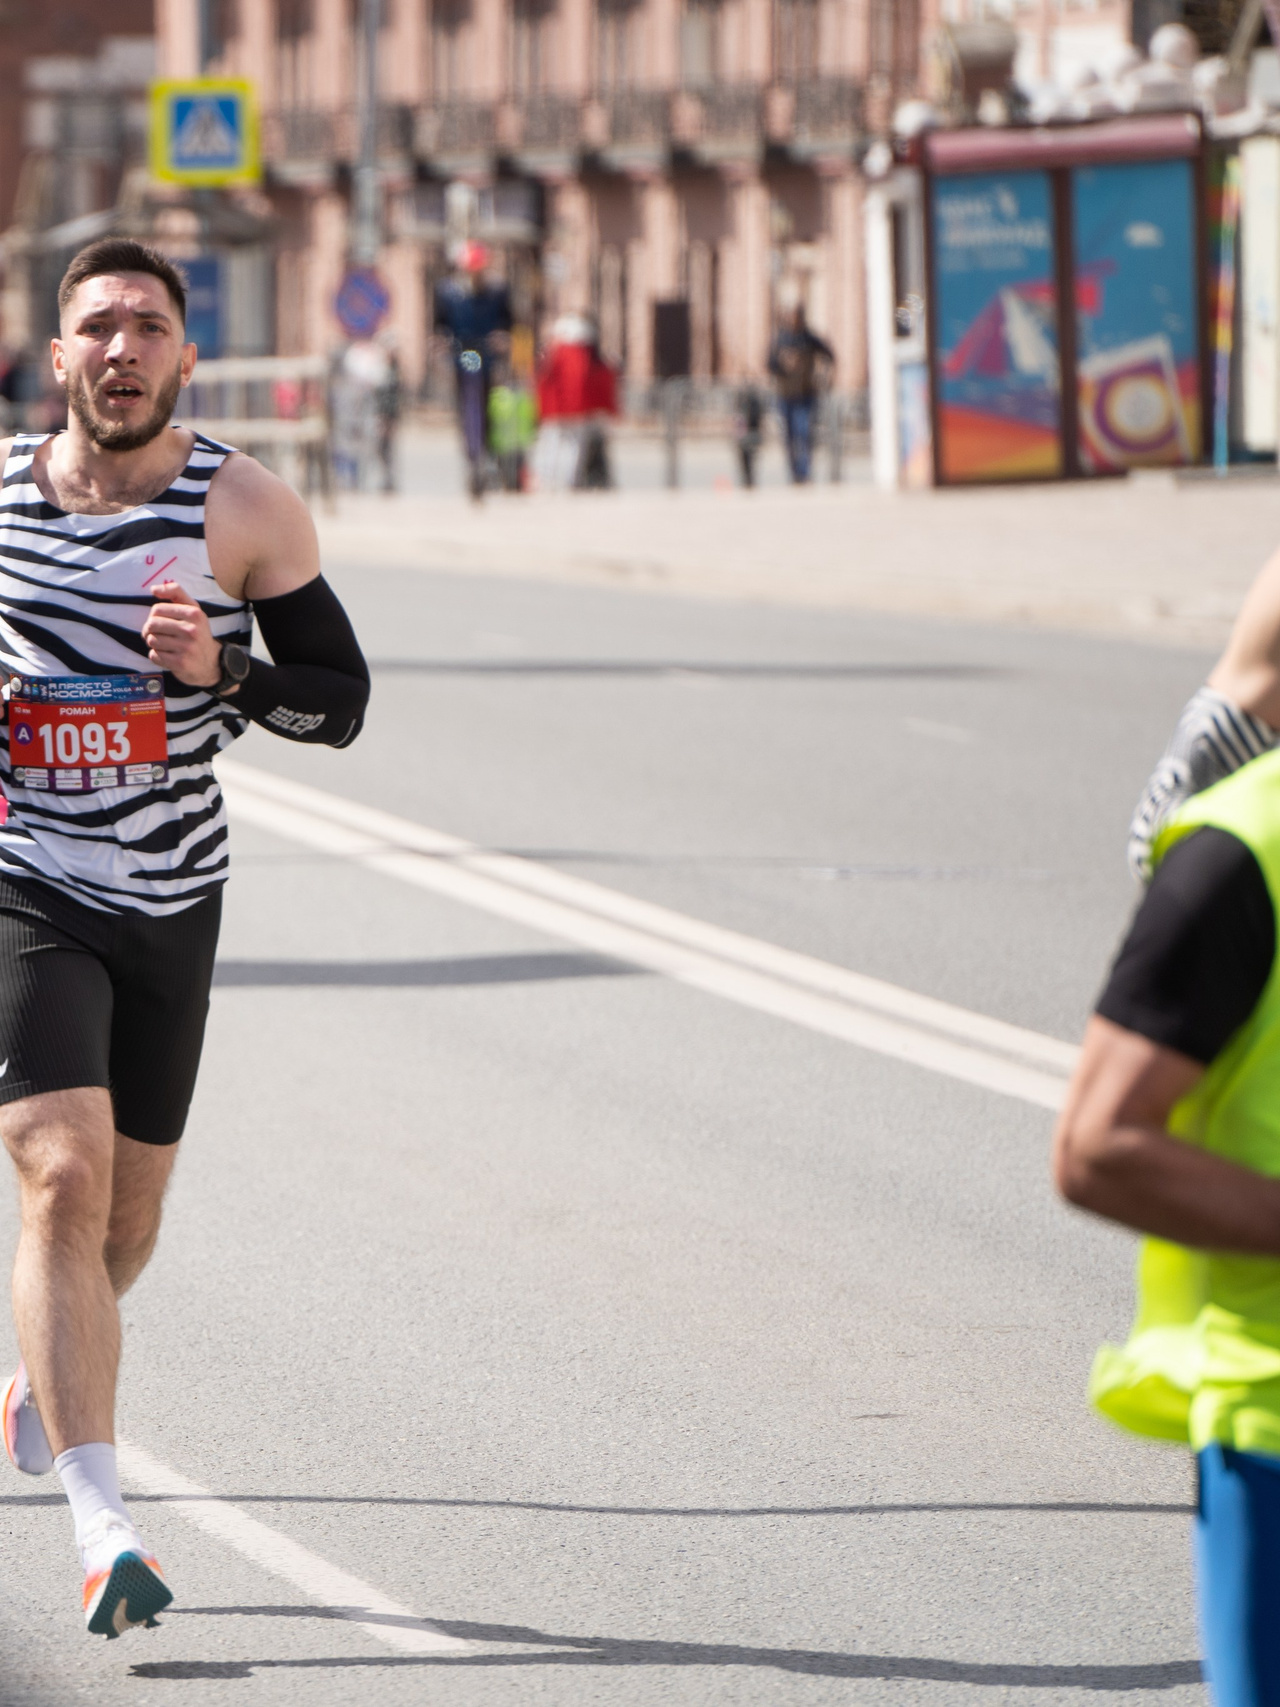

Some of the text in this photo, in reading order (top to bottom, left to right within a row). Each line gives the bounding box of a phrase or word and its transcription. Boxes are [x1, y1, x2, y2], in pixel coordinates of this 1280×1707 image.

[48, 681, 112, 690] Я ПРОСТО
[48, 689, 113, 698] КОСМОС
[59, 707, 96, 716] РОМАН
[38, 721, 131, 764] 1093
